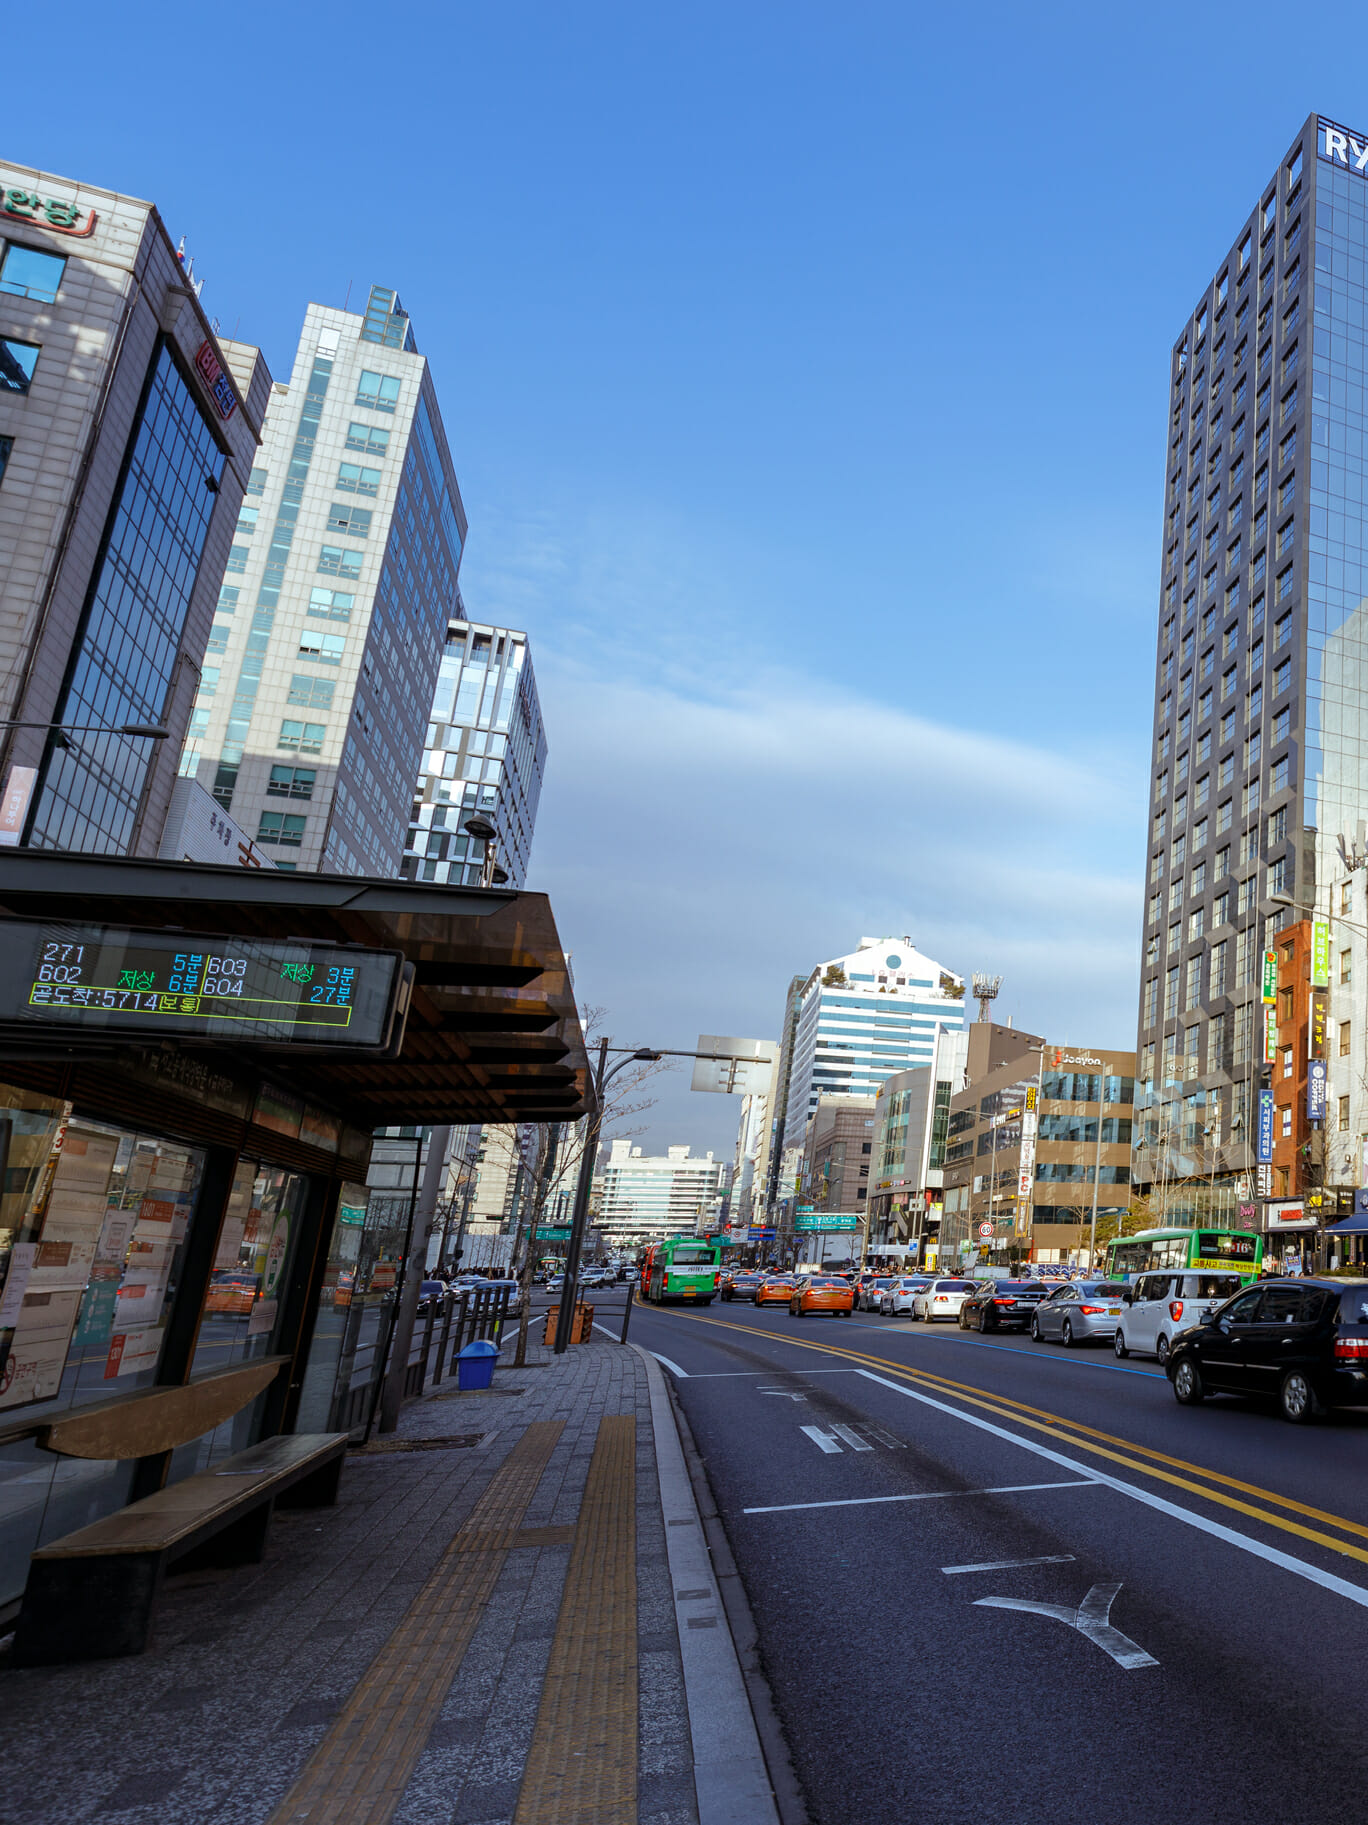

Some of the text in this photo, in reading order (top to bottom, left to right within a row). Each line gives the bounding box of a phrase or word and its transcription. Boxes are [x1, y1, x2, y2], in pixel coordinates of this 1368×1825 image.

[0, 189, 81, 226] 안당
[44, 943, 355, 986] 271 5분 603 저상 3분
[1316, 926, 1327, 977] 허브하우스
[38, 965, 352, 1006] 602 저상 6분 604 27분
[981, 1225, 992, 1234] 60
